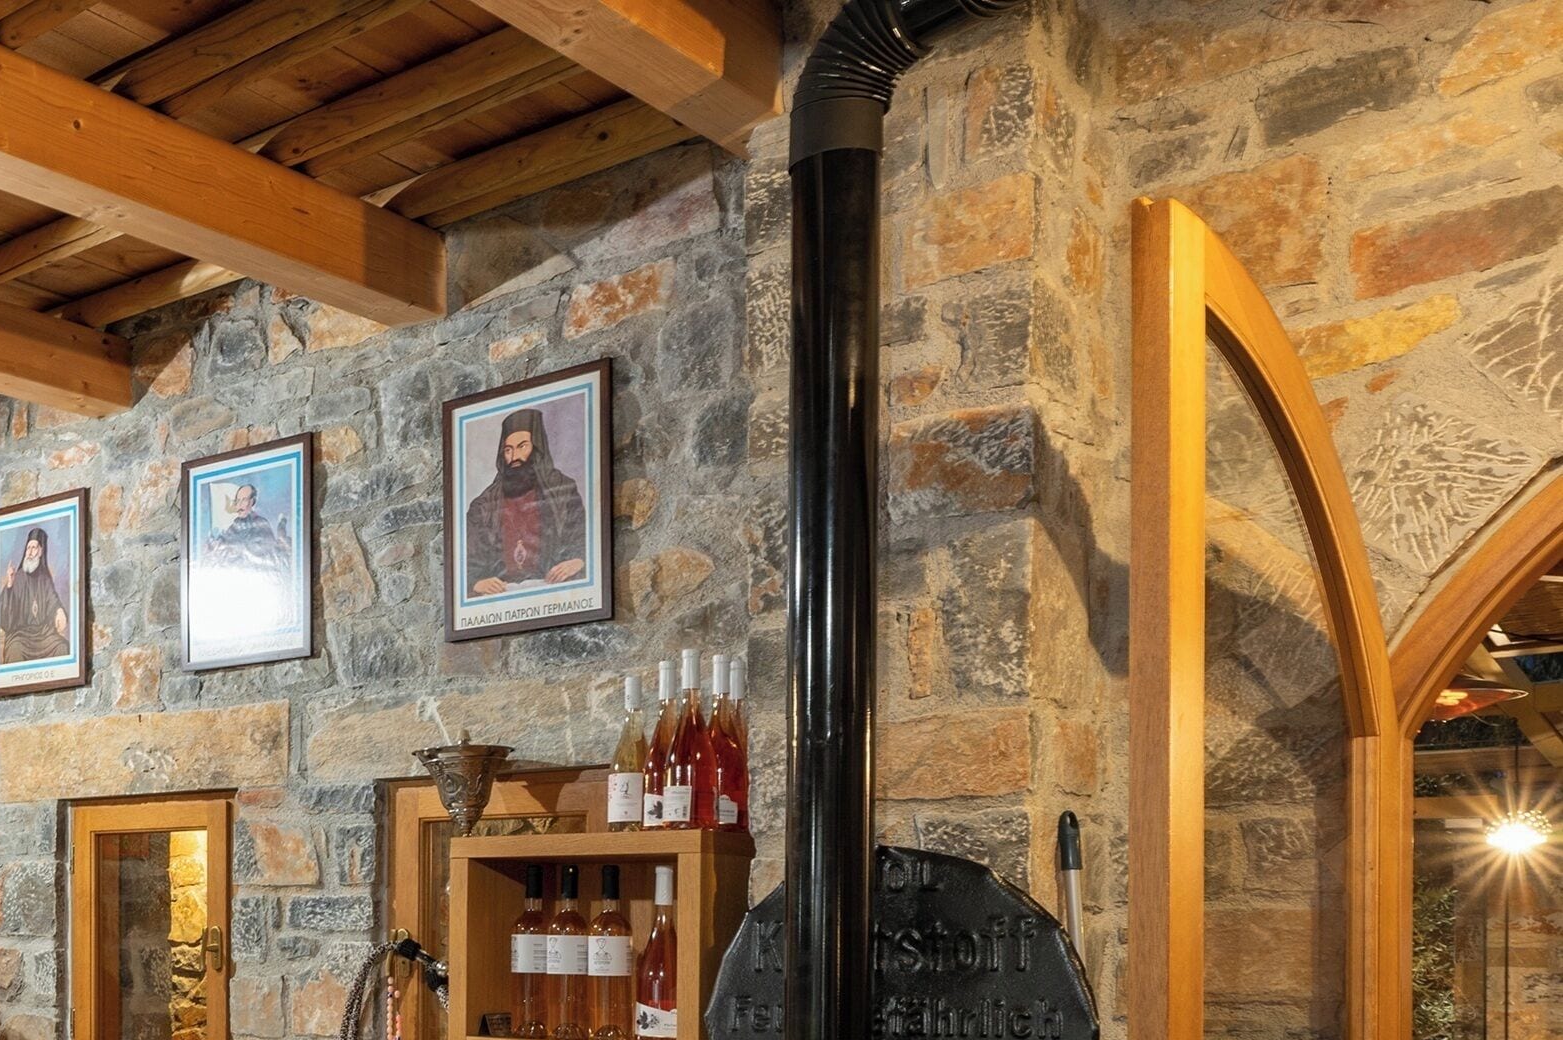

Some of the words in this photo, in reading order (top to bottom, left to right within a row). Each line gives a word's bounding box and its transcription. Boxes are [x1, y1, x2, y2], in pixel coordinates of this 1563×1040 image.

[460, 612, 503, 628] ΠΑΛΑΙΩΝ
[504, 606, 540, 621] ΠΑΤΡΩΝ
[542, 597, 594, 615] ΓΕΡΜΑΝΟΣ
[753, 917, 1035, 972] Ktstoff
